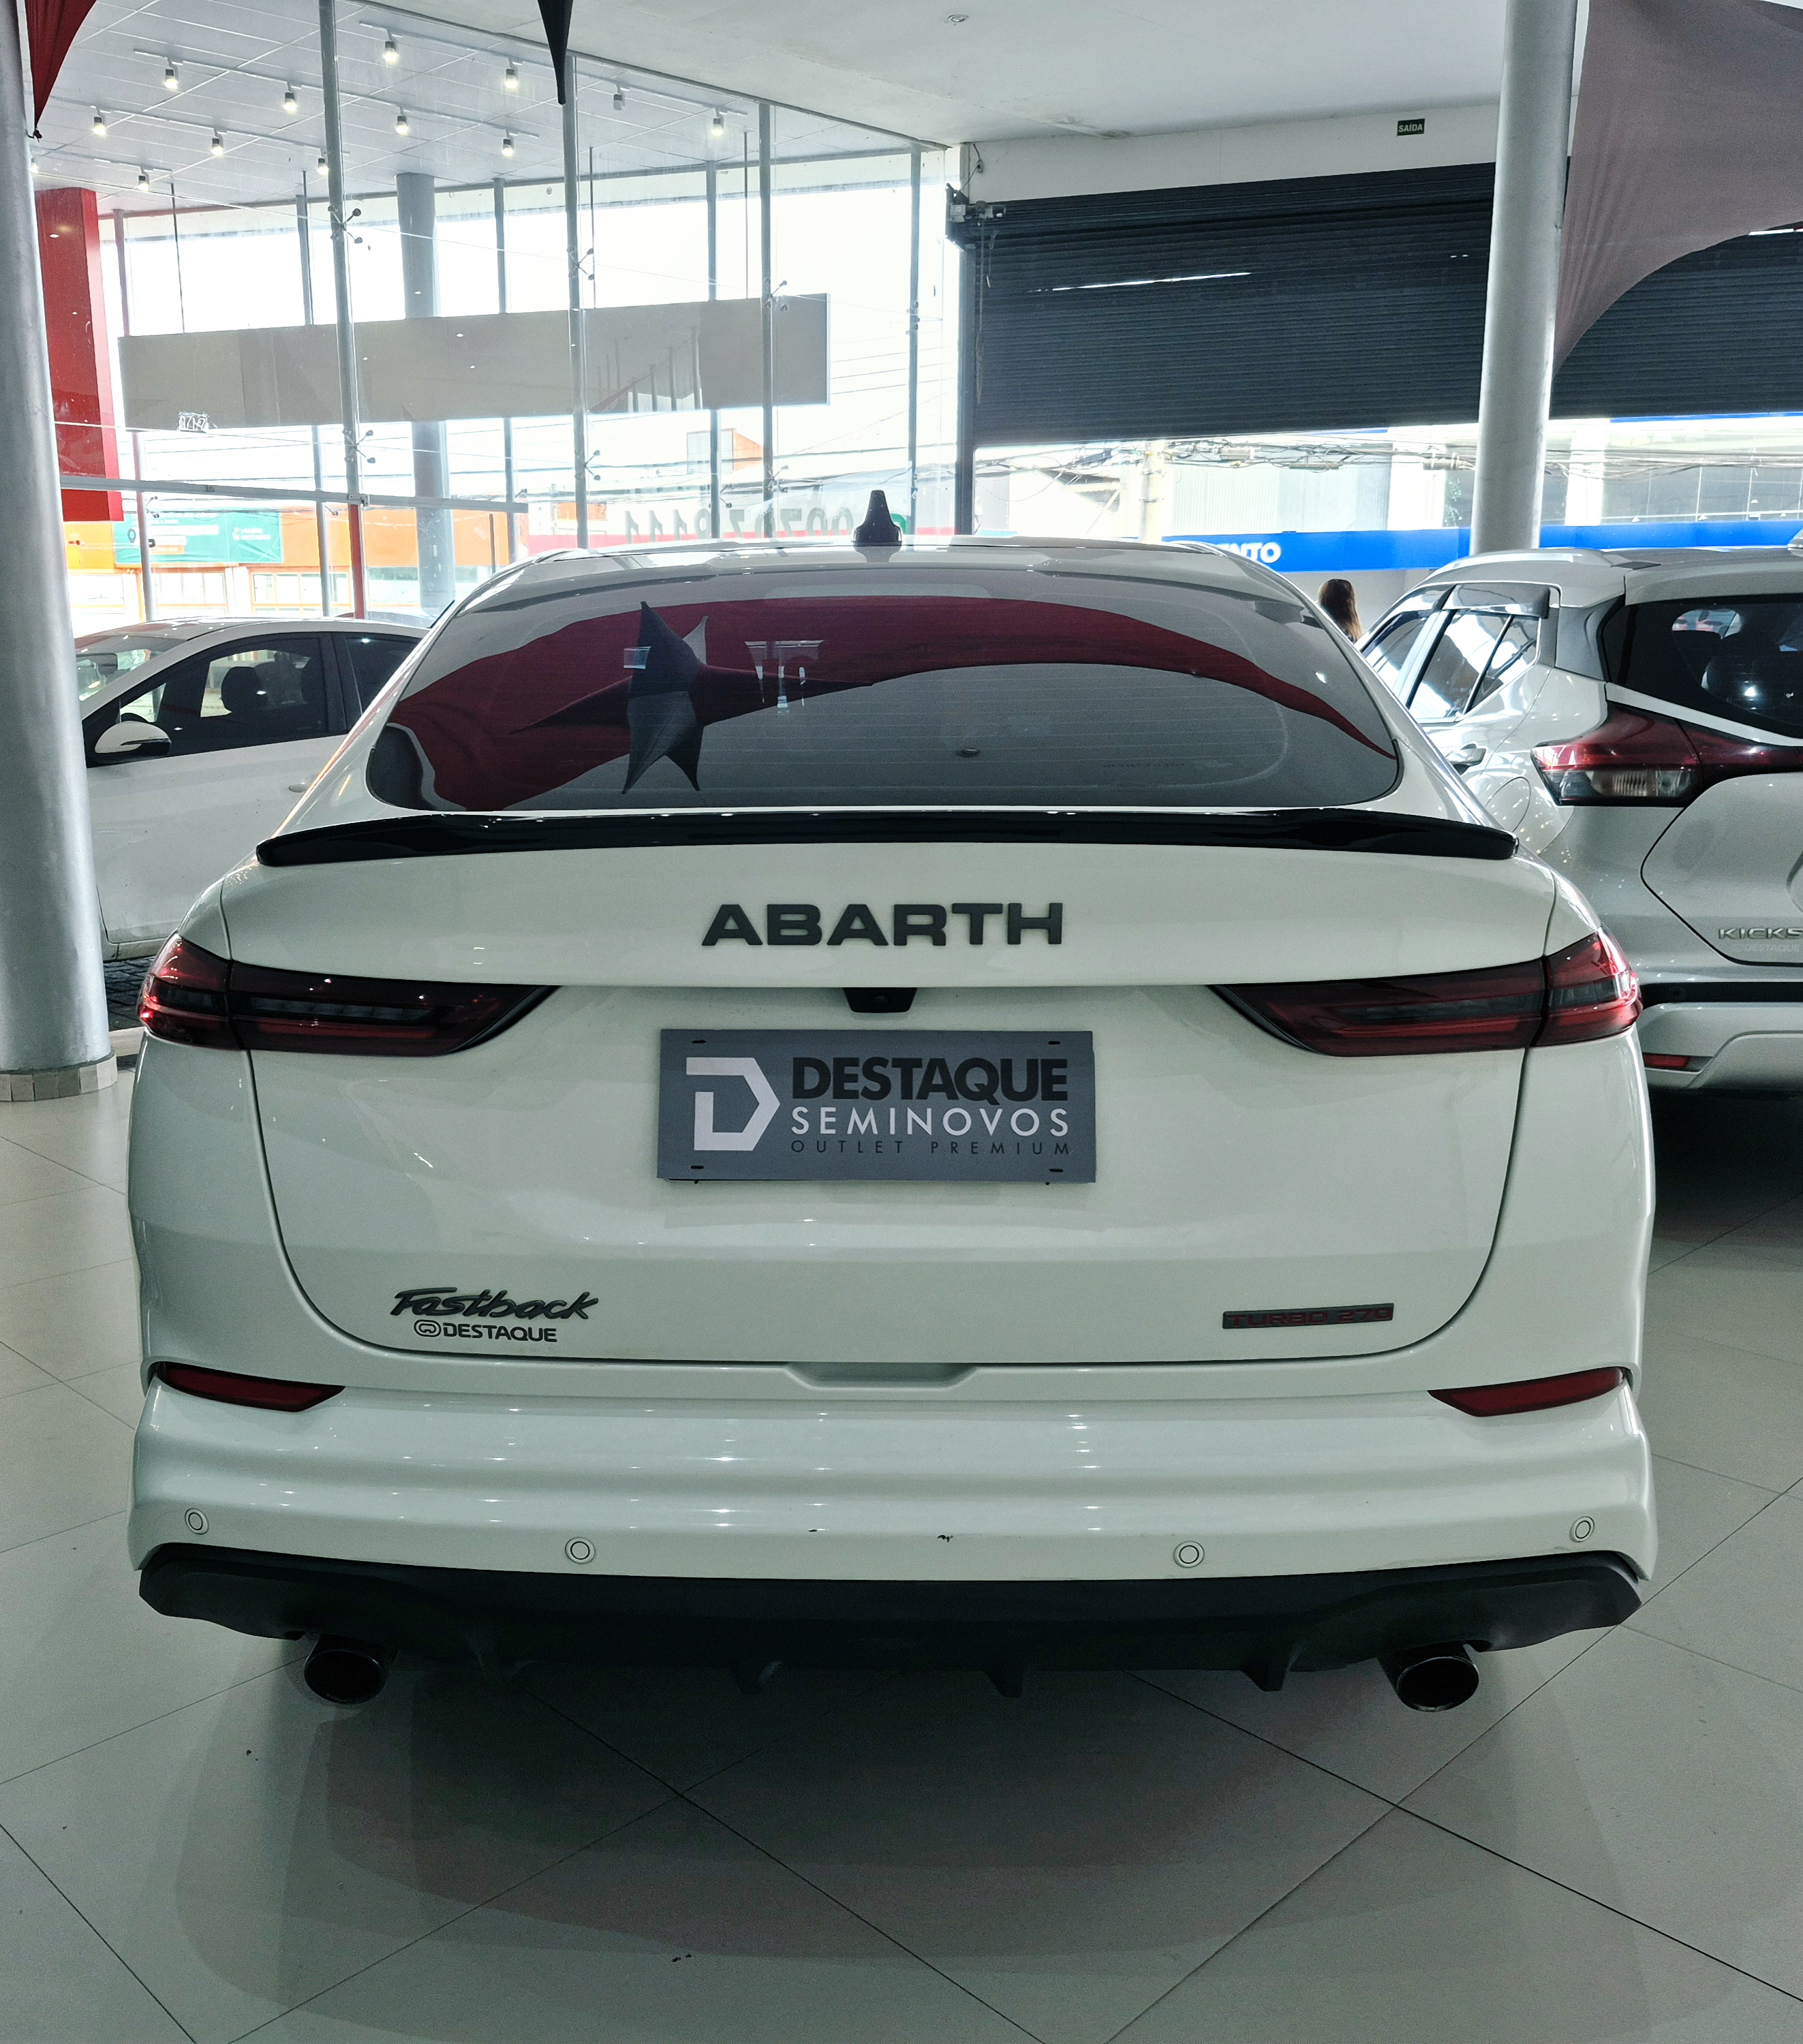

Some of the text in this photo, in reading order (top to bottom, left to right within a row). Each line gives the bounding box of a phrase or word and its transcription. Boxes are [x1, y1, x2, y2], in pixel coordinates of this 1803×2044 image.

[1398, 123, 1423, 133] SAÍDA
[701, 903, 1063, 946] ABARTH
[1718, 927, 1803, 940] KICKS
[791, 1056, 1068, 1105] DESTAQUE
[790, 1106, 1069, 1136] SEMINOVOS
[790, 1140, 1070, 1155] OUTLET PREMIUM
[390, 1286, 598, 1320] Fastback
[1227, 1307, 1394, 1327] TURBO 270
[443, 1322, 557, 1342] DESTAQUE
